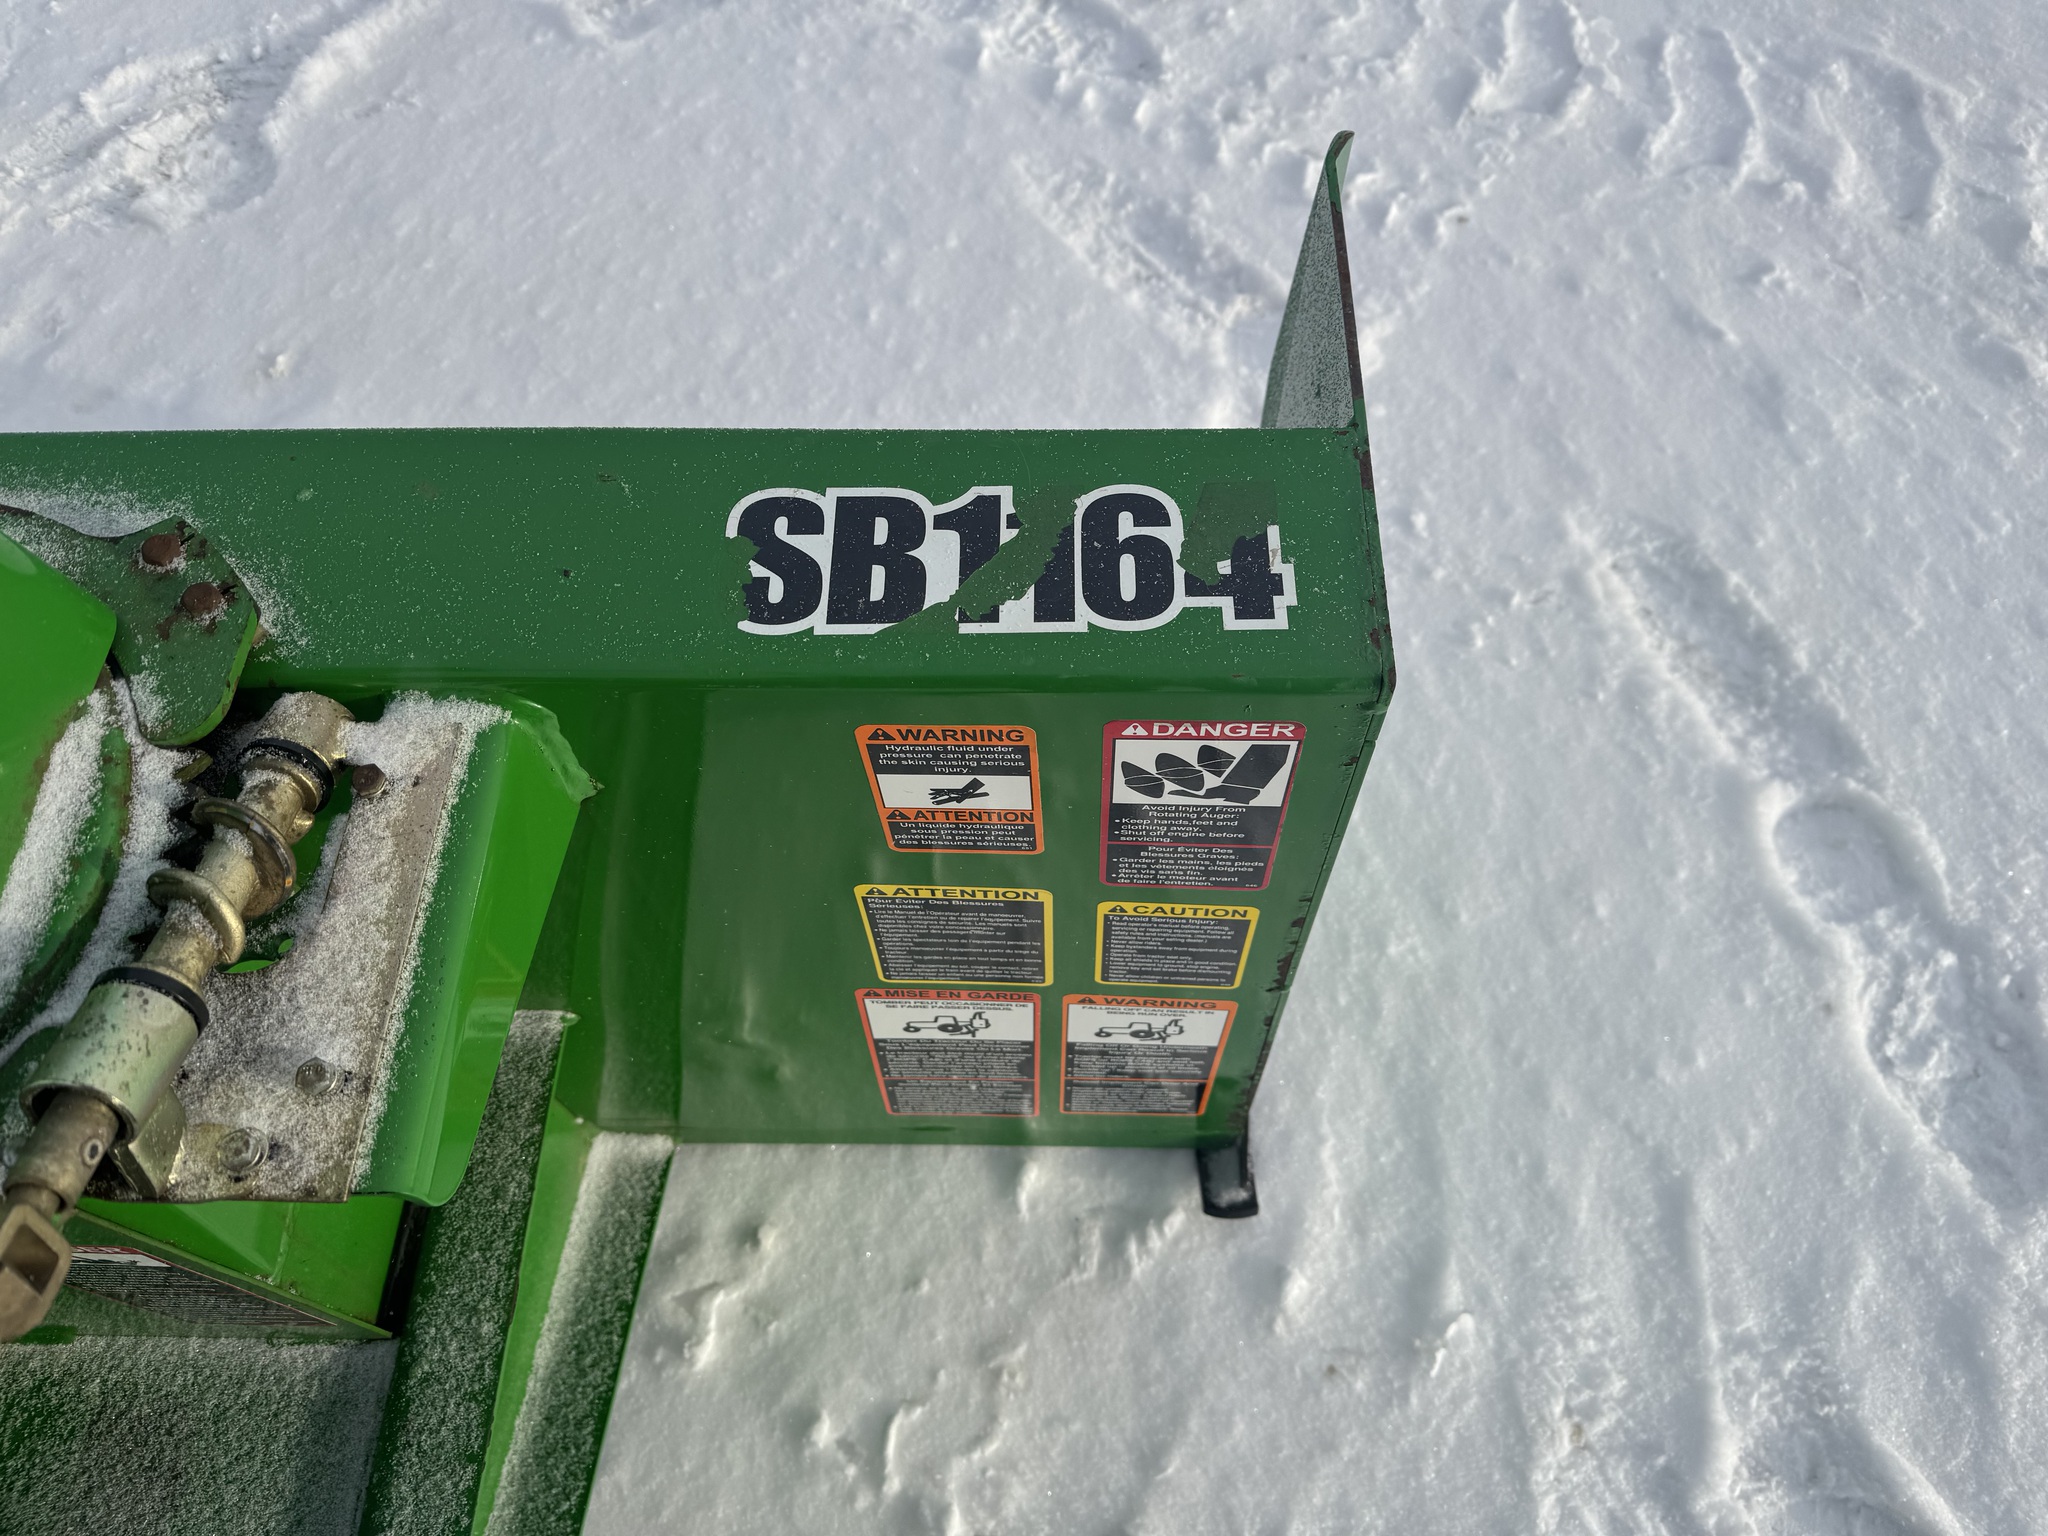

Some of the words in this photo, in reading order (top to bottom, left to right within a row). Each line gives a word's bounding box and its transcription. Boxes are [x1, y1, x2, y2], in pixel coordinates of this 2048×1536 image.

[896, 728, 1024, 742] WARNING
[1152, 723, 1295, 737] DANGER
[914, 810, 1033, 822] ATTENTION
[893, 887, 1038, 900] ATTENTION
[1133, 905, 1248, 918] CAUTION
[885, 989, 929, 998] MISE
[968, 991, 1034, 1001] GARDE
[1103, 997, 1216, 1009] WARNING
